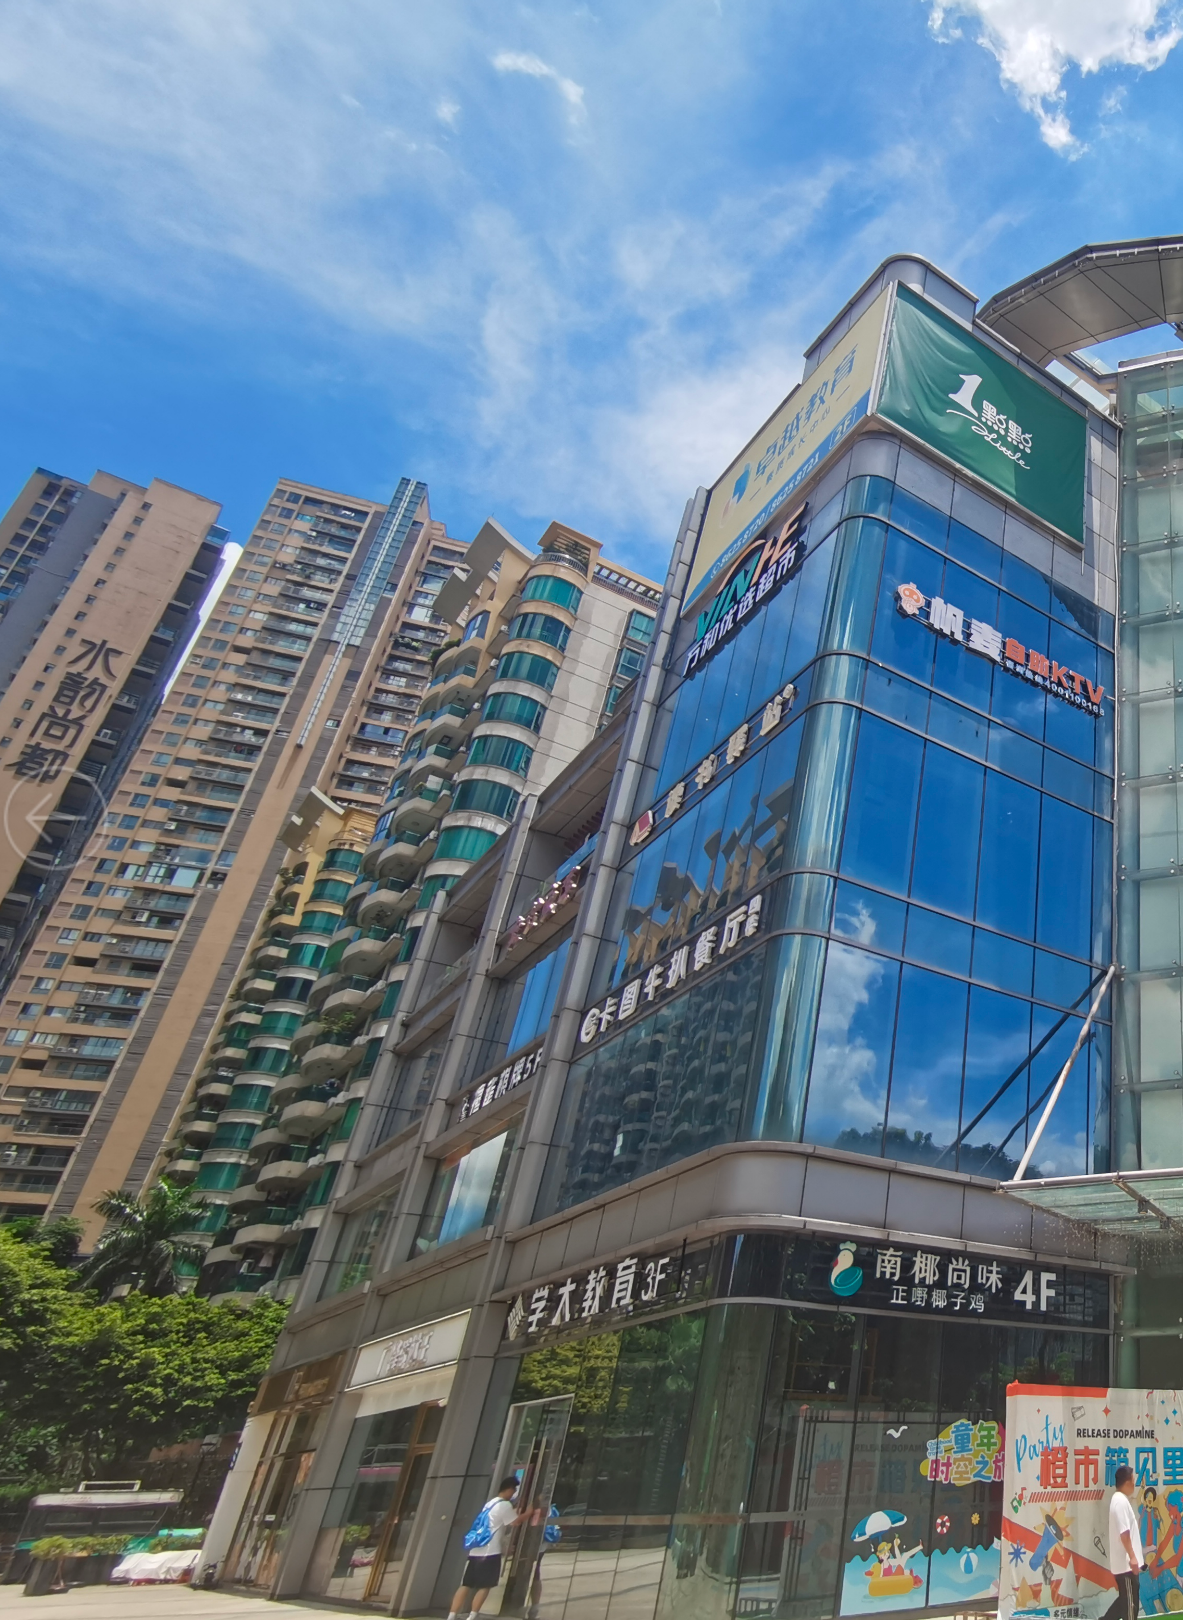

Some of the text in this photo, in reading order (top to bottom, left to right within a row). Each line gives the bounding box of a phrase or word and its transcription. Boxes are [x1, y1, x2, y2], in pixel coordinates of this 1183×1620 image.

[754, 343, 858, 481] 卓越教育
[834, 415, 853, 442] 2F
[682, 541, 798, 678] 万和优选超市
[5, 638, 125, 784] 水韵尚都
[526, 1256, 670, 1333] 学大教育 3F
[875, 1247, 1057, 1311] 南椰尚味 4F
[890, 1285, 985, 1313] 正嘢椰子鸡
[951, 1421, 998, 1454] 童年
[1015, 1414, 1067, 1473] Party
[1076, 1424, 1155, 1440] RELEASE DOPAMINE
